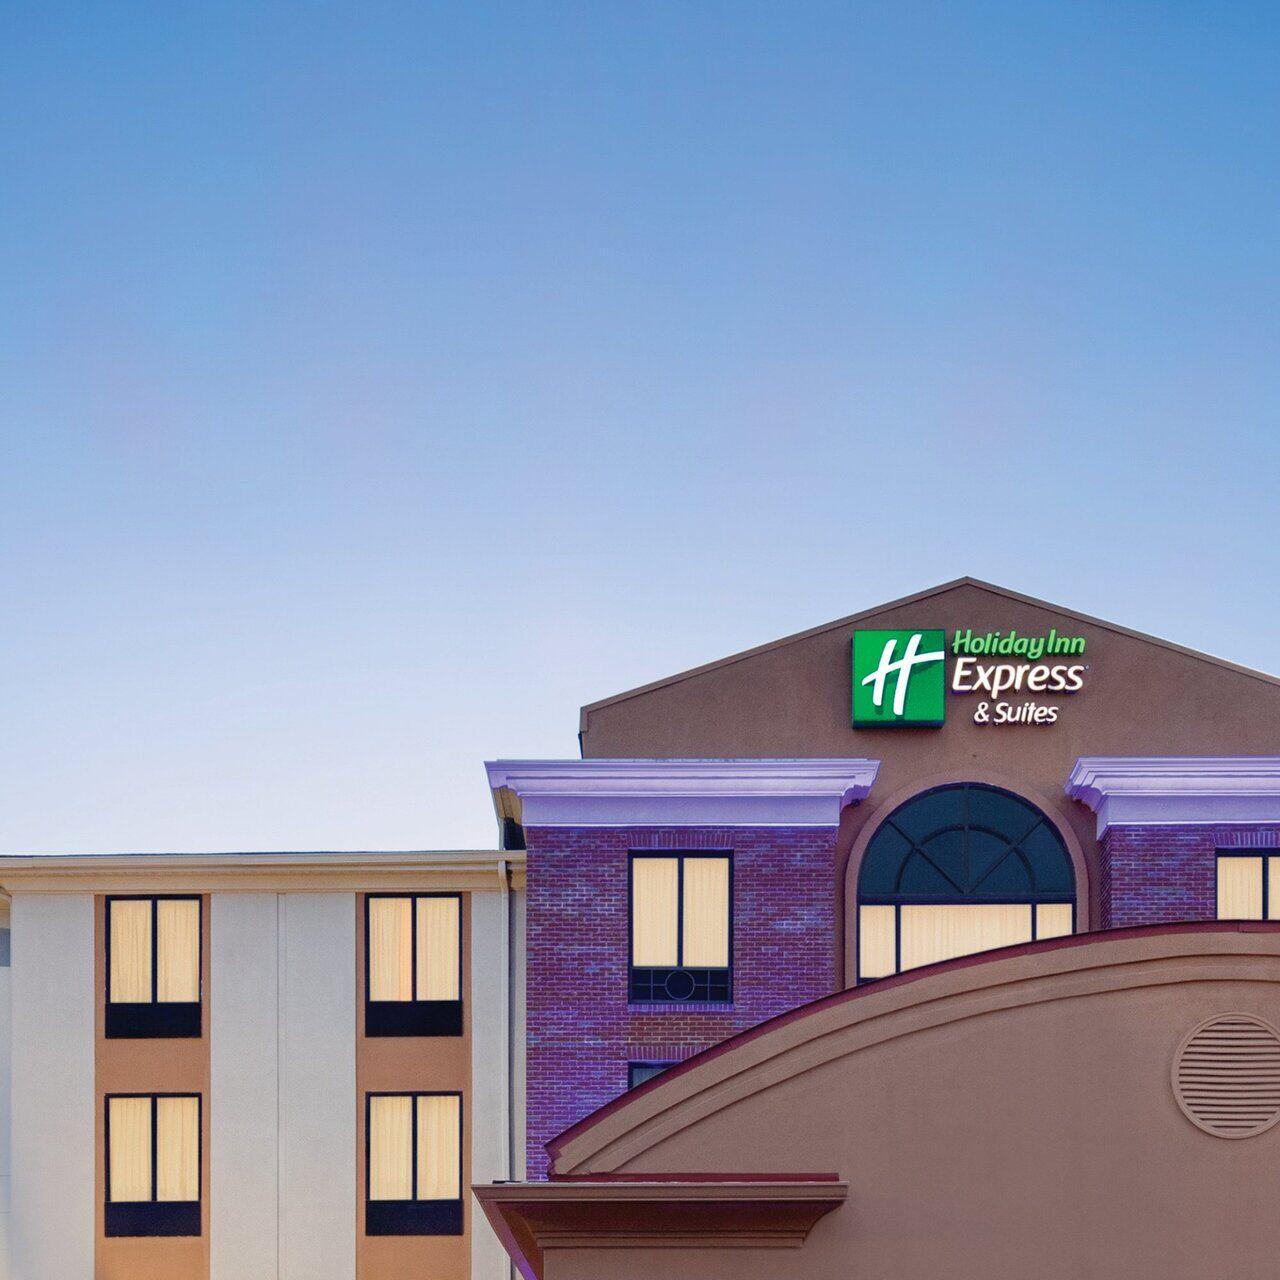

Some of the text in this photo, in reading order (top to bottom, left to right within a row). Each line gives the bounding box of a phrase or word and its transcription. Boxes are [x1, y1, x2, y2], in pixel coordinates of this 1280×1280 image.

[952, 629, 1086, 659] Holiday Inn
[952, 657, 1085, 699] Express
[973, 701, 1059, 723] & Suites
